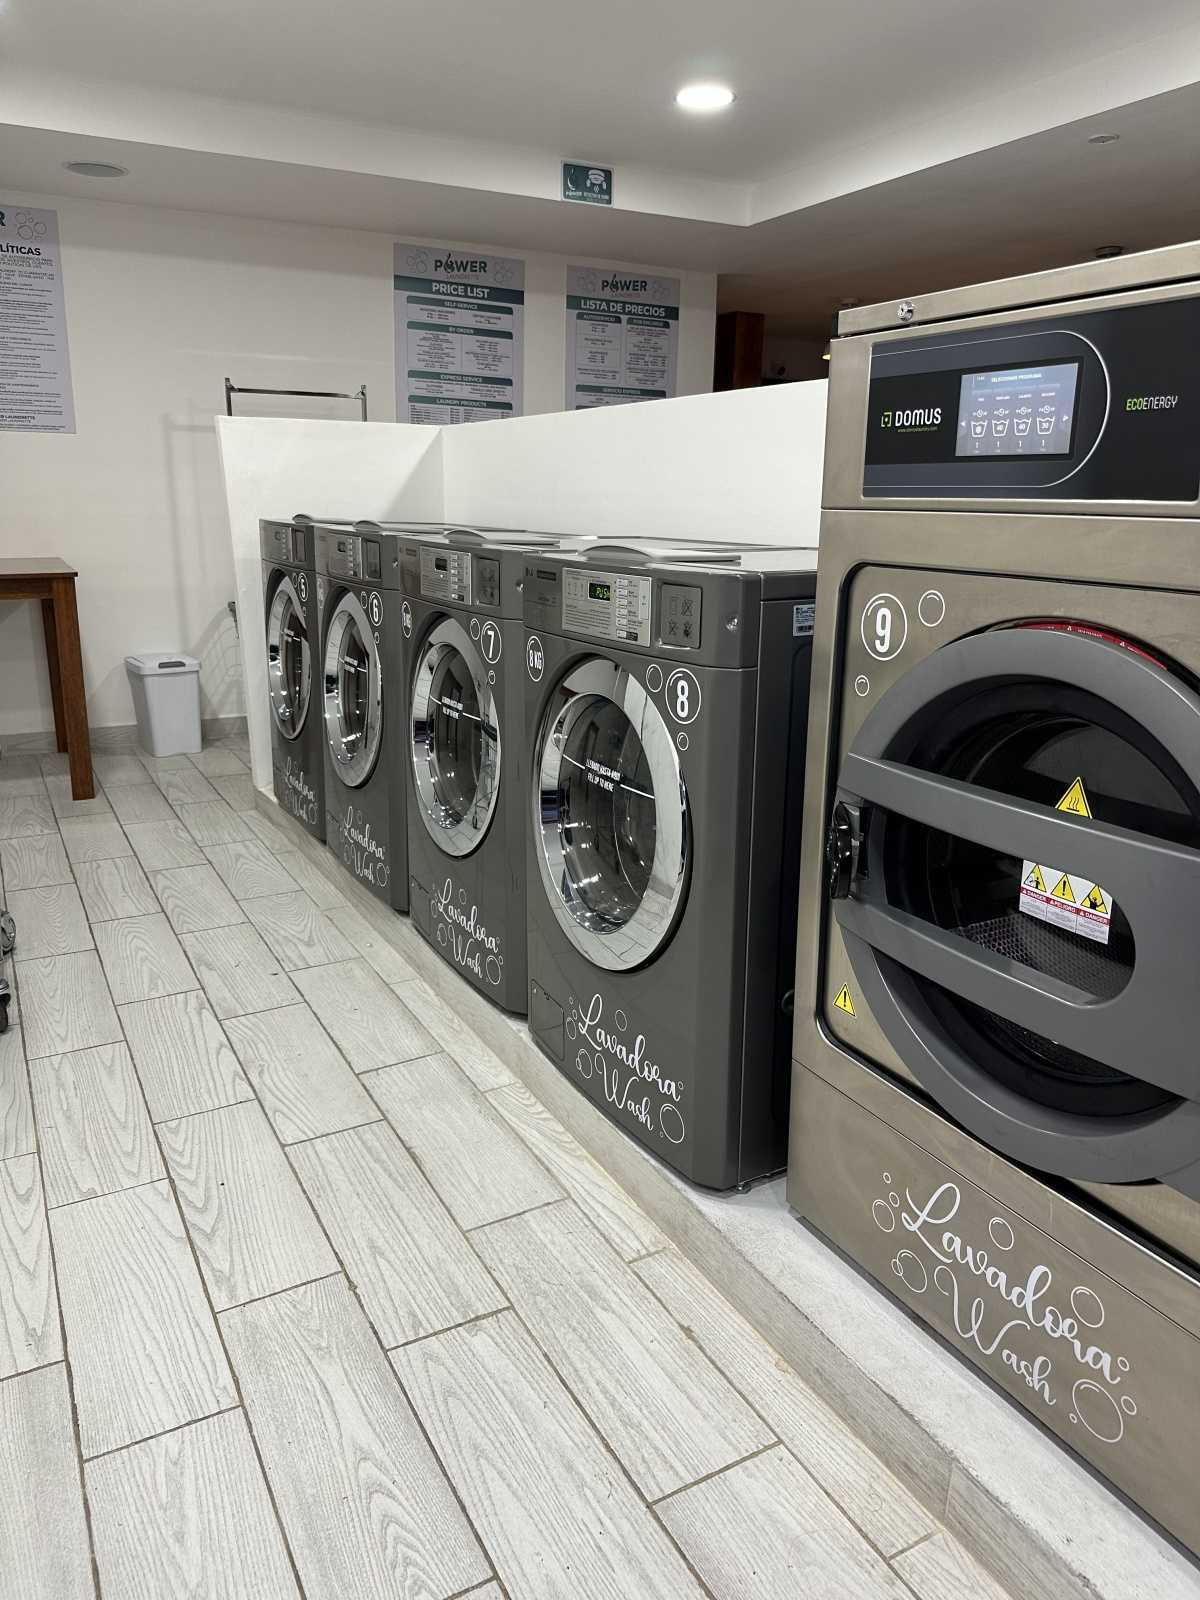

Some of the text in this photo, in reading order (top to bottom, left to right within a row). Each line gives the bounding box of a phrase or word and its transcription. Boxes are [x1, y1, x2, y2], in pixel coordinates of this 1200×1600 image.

[434, 254, 487, 273] POWER
[432, 282, 490, 298] PRICE LIST
[601, 274, 647, 292] POWER
[581, 299, 665, 317] LISTA DE PRECIOS
[1126, 395, 1178, 411] ECOENERGY
[895, 408, 942, 426] DOMUS
[372, 599, 379, 625] 6
[875, 607, 892, 653] 9
[487, 630, 495, 658] 7
[529, 650, 542, 670] 8 KG
[676, 679, 689, 718] 8
[437, 878, 499, 954] Lavadora
[1085, 912, 1108, 925] DANGER
[448, 924, 483, 979] Wash
[578, 993, 681, 1102] Lavadora
[595, 1052, 654, 1131] Wash
[901, 1182, 1121, 1384] Lavadora
[933, 1265, 1056, 1405] Wash
